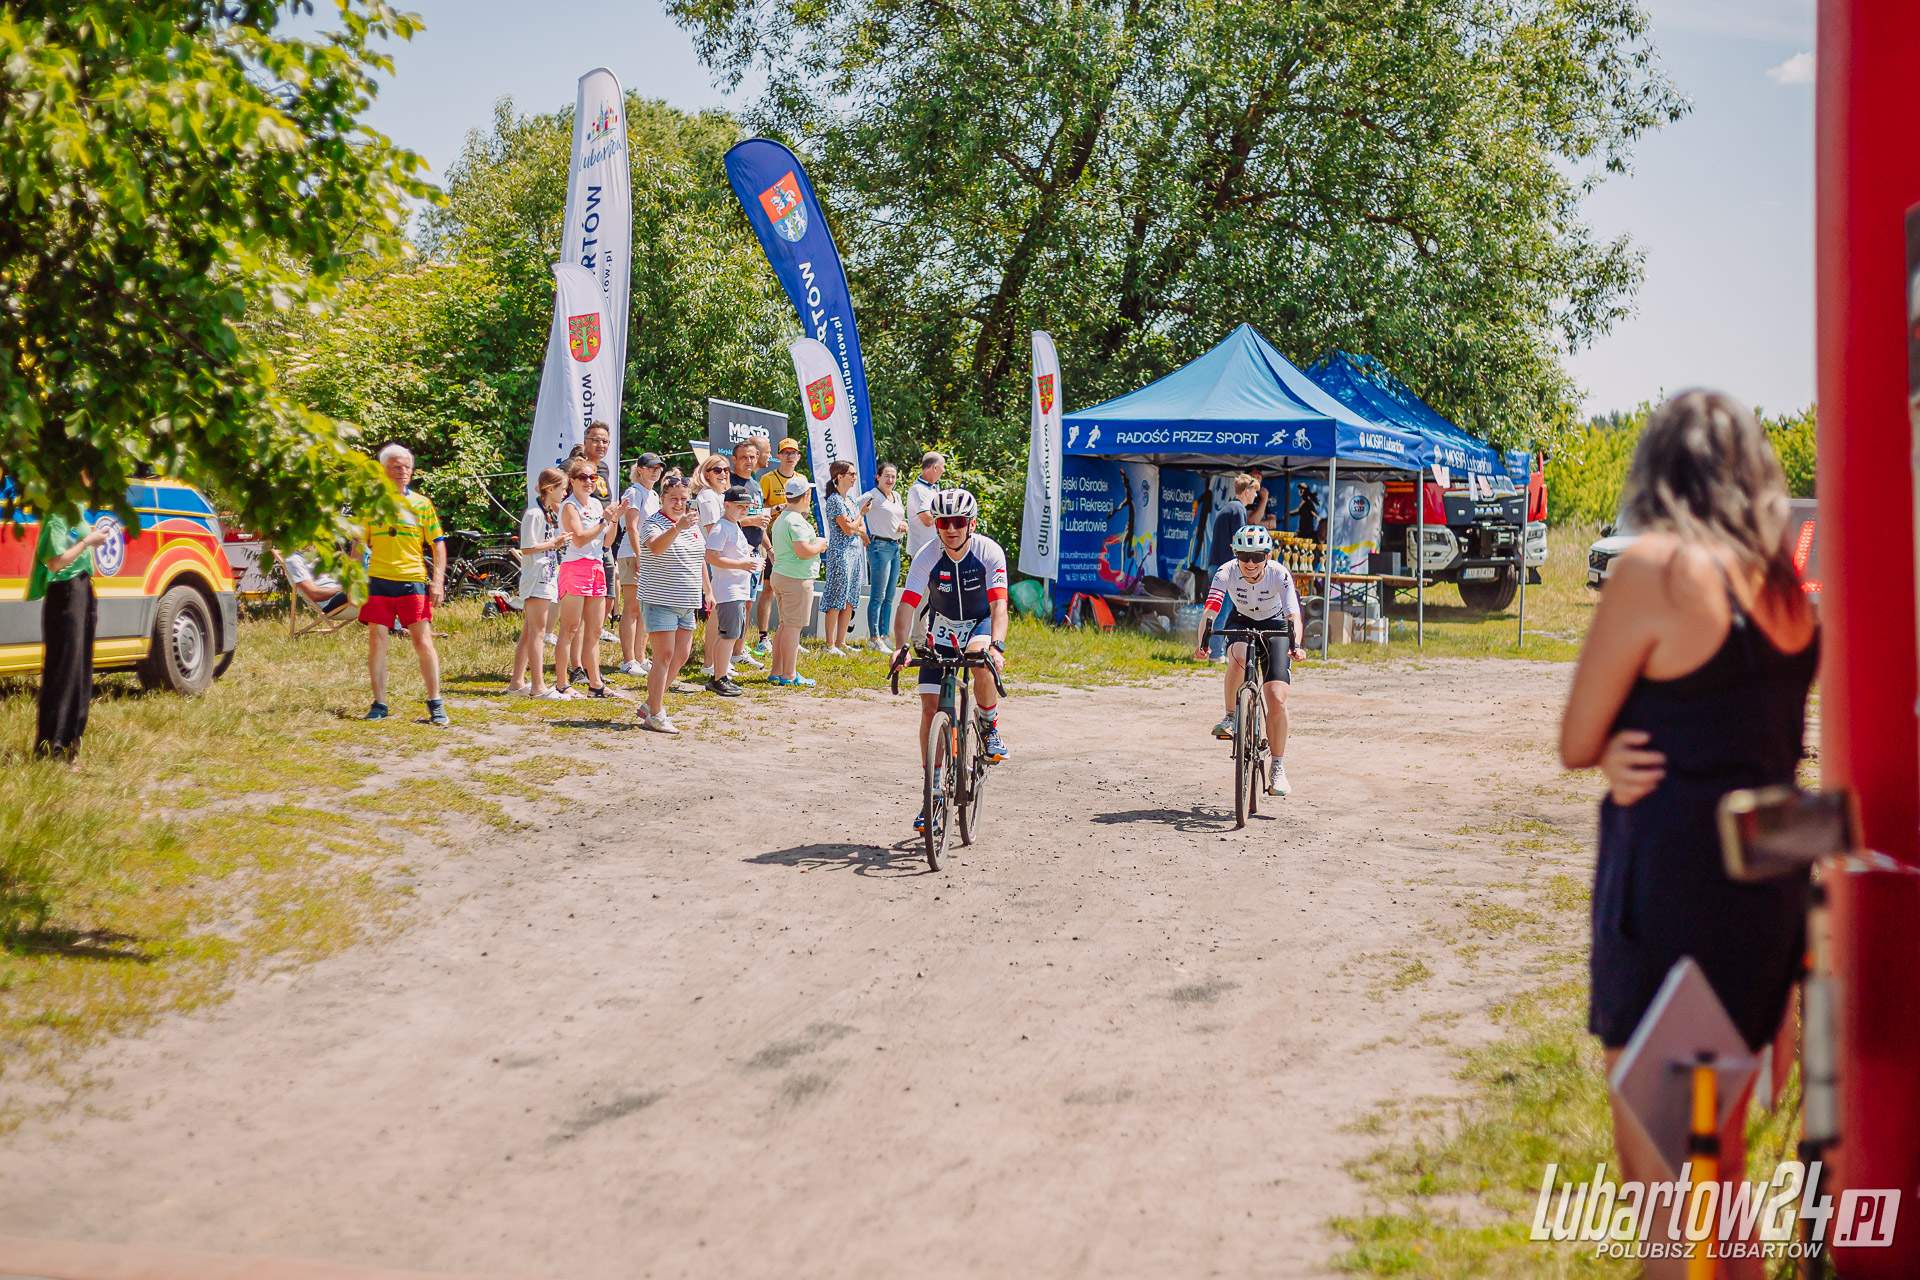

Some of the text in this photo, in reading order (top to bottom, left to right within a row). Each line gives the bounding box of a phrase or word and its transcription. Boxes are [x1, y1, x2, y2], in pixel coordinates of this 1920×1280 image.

[581, 186, 602, 270] RTÓW
[799, 262, 828, 346] RTÓW
[1117, 428, 1259, 445] RADOŚĆ PRZEZ SPORT
[1063, 476, 1078, 493] ejski
[1474, 507, 1503, 515] MAN
[1065, 517, 1107, 532] Lubartowie
